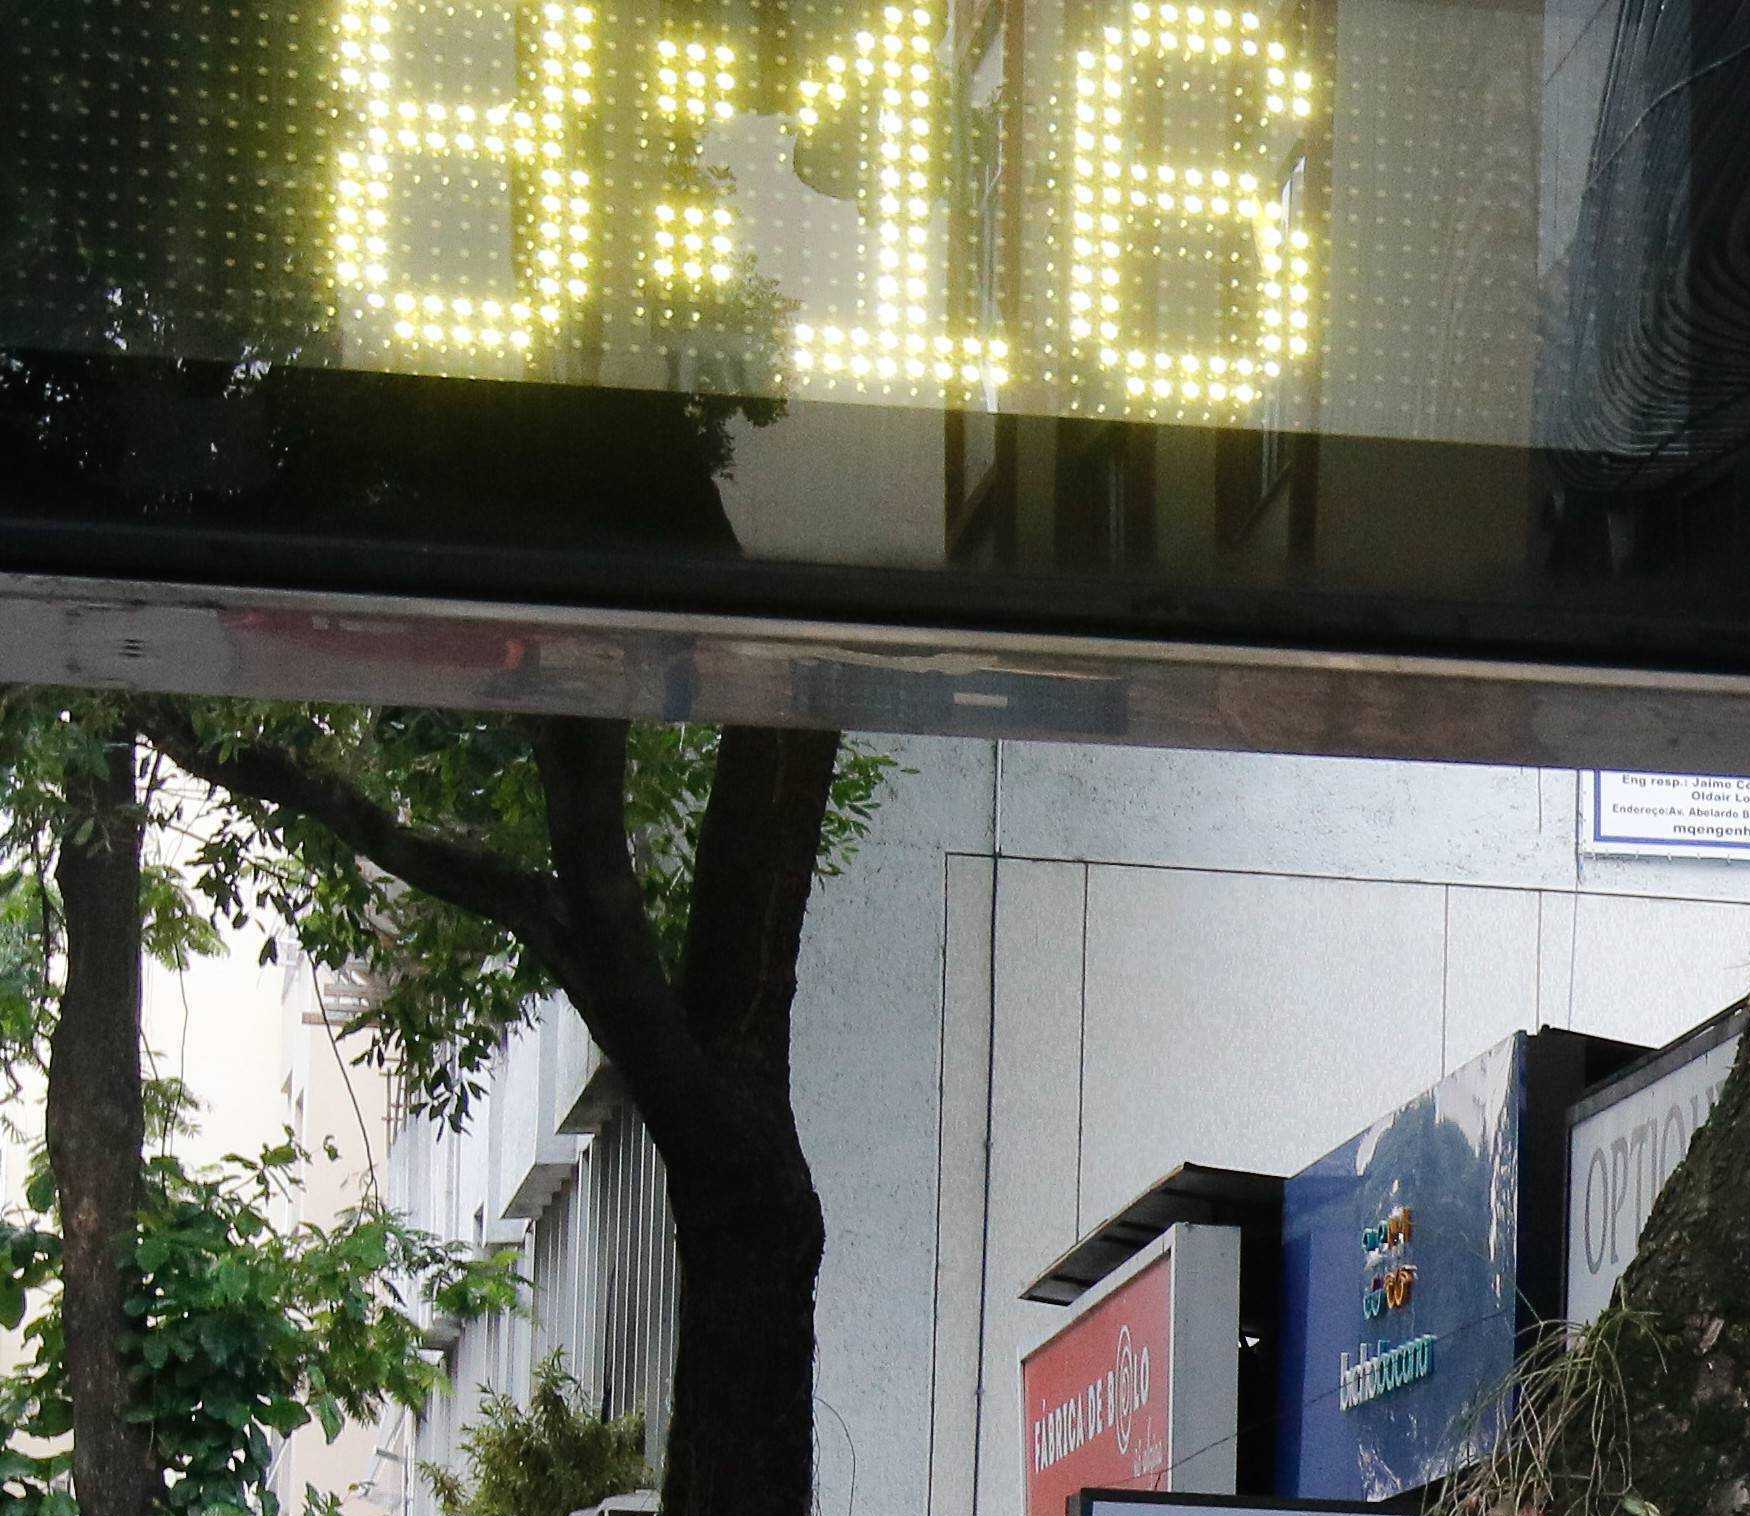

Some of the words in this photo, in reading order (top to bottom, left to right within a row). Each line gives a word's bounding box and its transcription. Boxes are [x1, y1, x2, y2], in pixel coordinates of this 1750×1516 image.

[1622, 774, 1647, 788] Eng
[1034, 1392, 1085, 1474] FÁBRICA
[1087, 1377, 1104, 1441] DE
